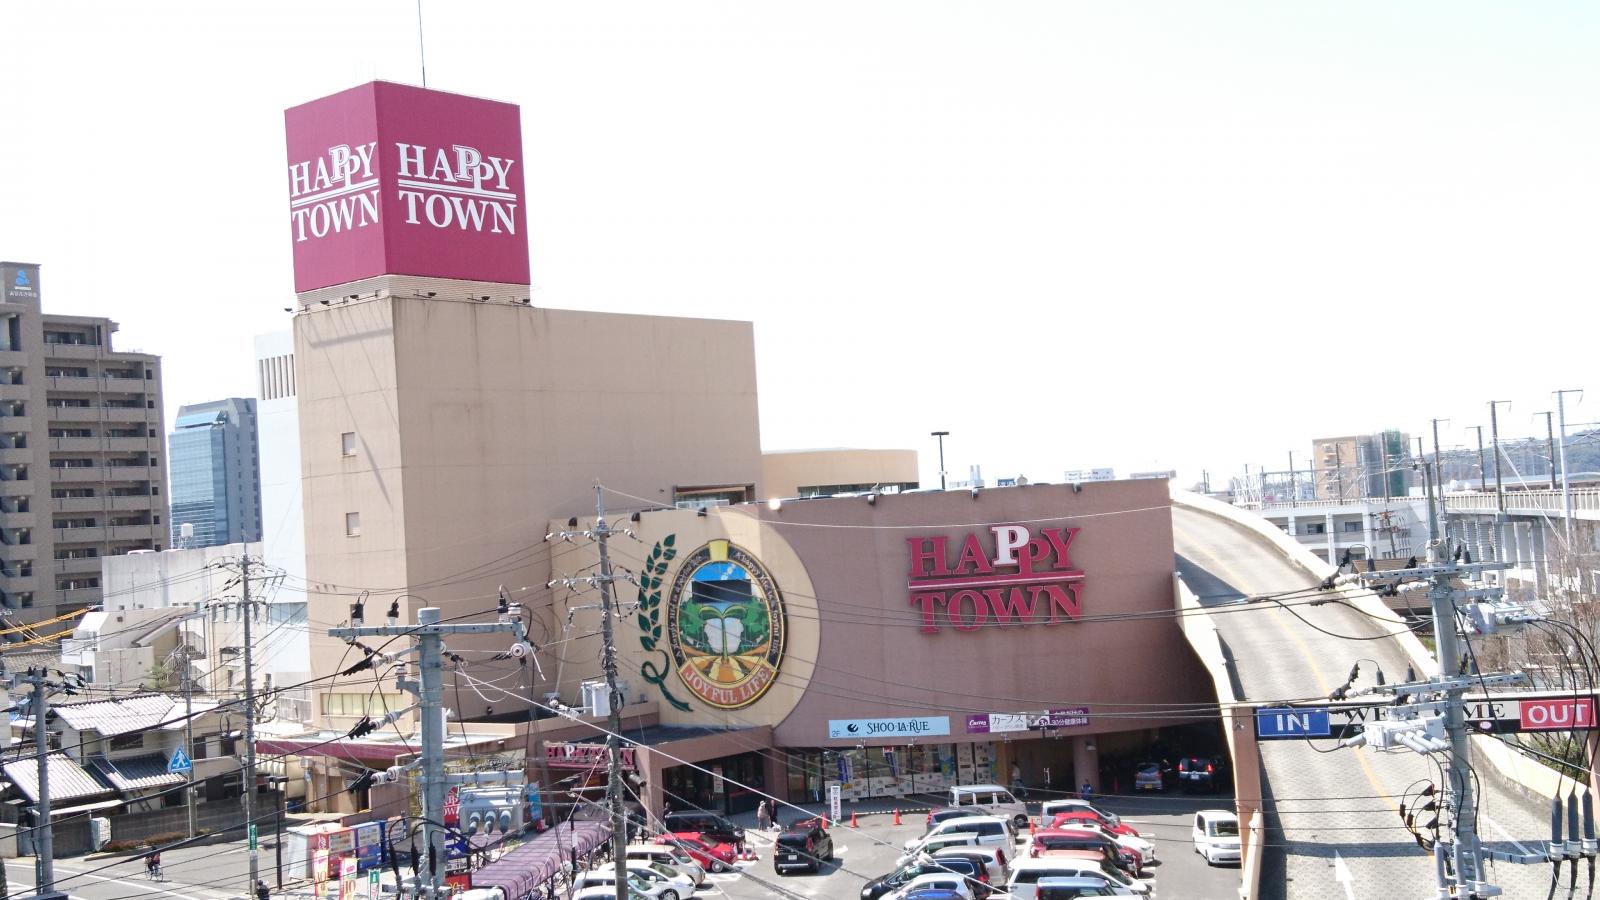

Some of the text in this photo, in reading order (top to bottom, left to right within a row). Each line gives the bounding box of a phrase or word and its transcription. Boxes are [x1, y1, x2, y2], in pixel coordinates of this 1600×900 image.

[289, 141, 377, 197] HAPPY
[395, 142, 515, 192] HAPPY
[292, 190, 380, 242] TOWN
[398, 190, 517, 235] TOWN
[906, 524, 1081, 577] HAPPY
[909, 583, 1085, 635] TOWN
[685, 667, 769, 703] JOYFUL LIFE
[1276, 714, 1310, 731] IN
[1528, 704, 1588, 726] OUT
